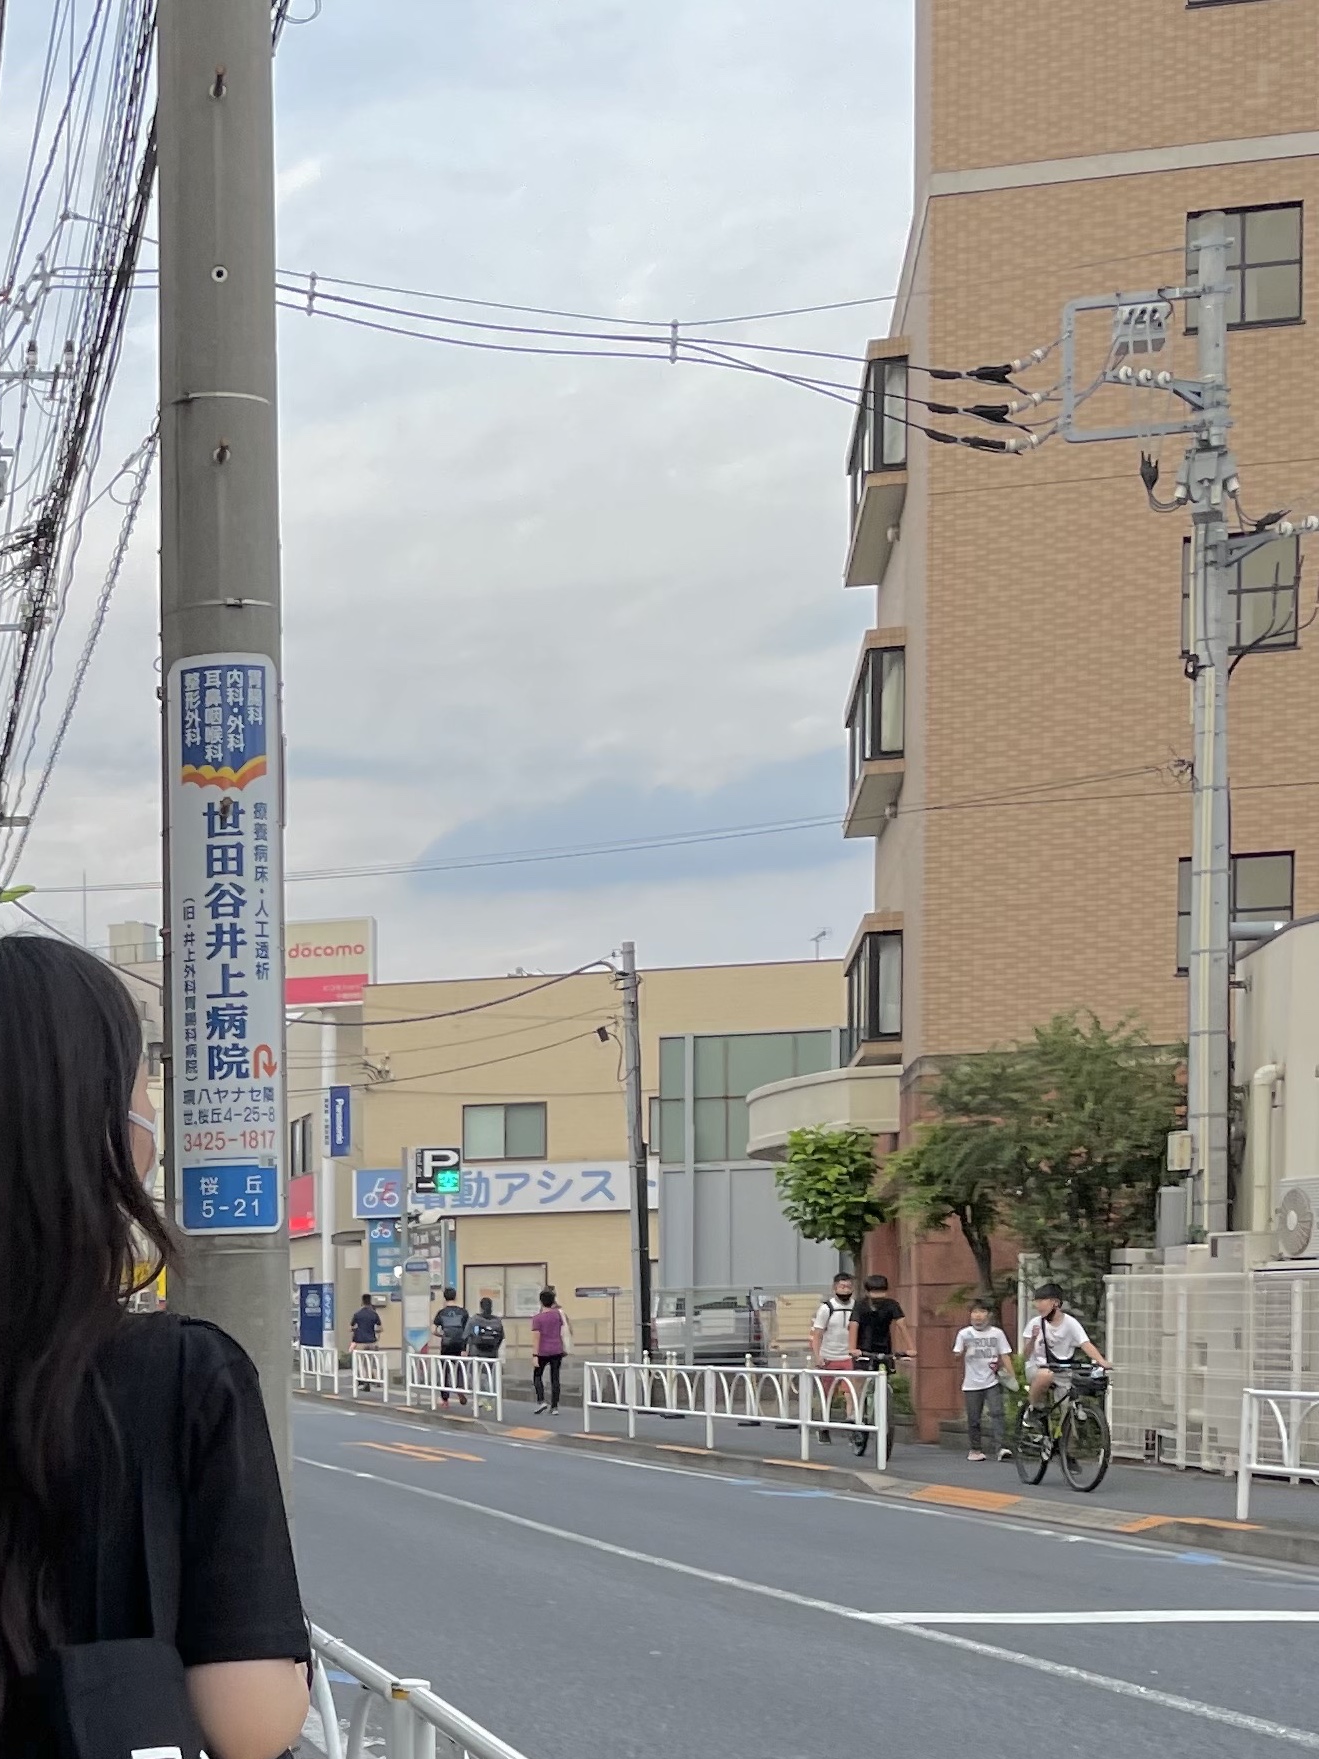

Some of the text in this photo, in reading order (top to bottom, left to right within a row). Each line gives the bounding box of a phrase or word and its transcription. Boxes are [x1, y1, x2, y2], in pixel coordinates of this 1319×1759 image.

[202, 799, 250, 1081] 世田谷井上病院
[287, 943, 365, 959] docomo
[183, 1129, 276, 1153] 3425-1817
[423, 1149, 459, 1178] P
[201, 1198, 260, 1218] 5-21
